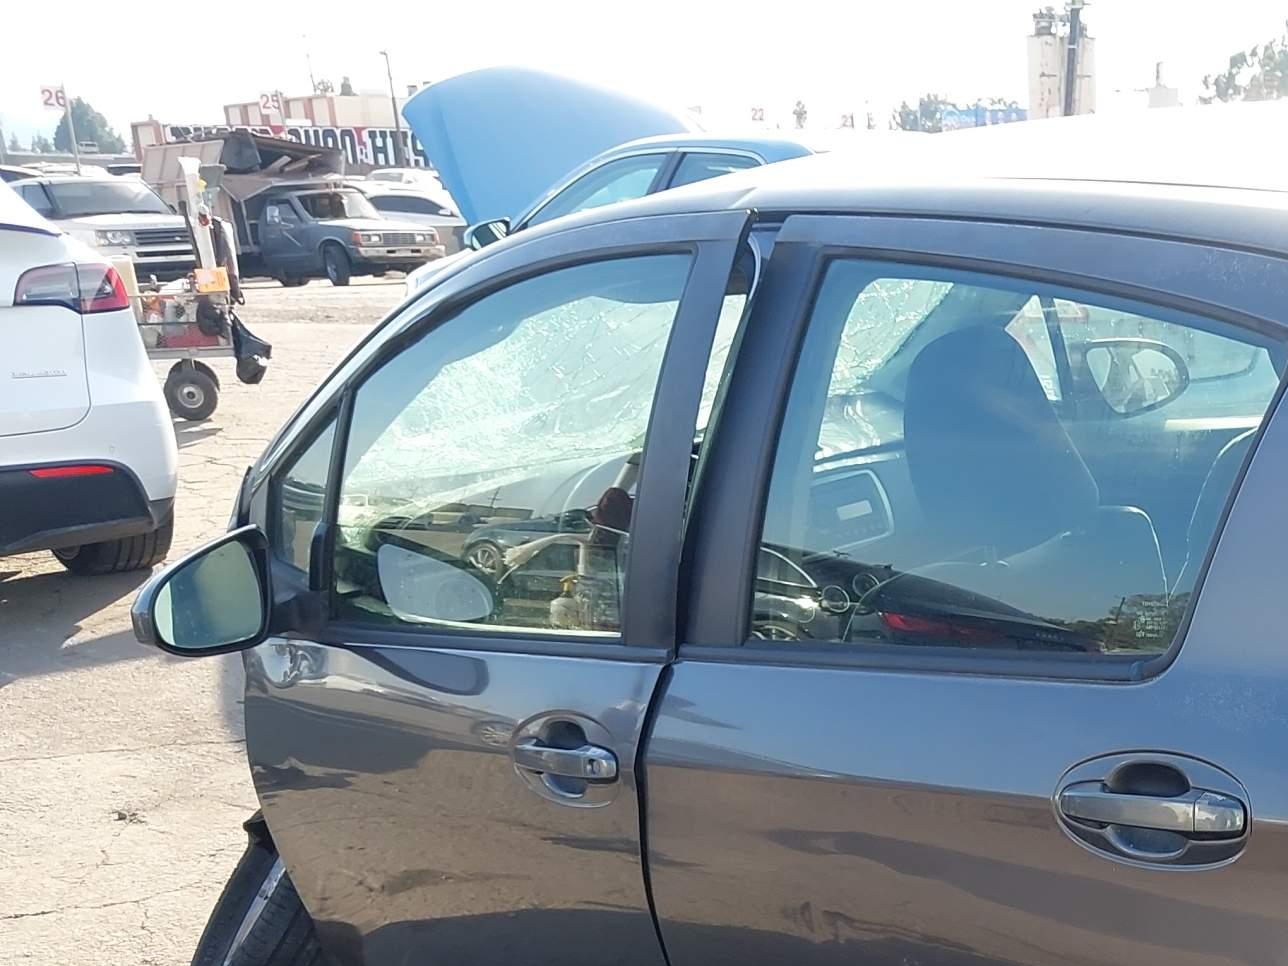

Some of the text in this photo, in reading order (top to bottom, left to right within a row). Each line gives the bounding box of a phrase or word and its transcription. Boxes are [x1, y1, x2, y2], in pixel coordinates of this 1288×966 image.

[41, 89, 65, 107] 26
[260, 94, 280, 109] 25
[752, 108, 764, 121] 22
